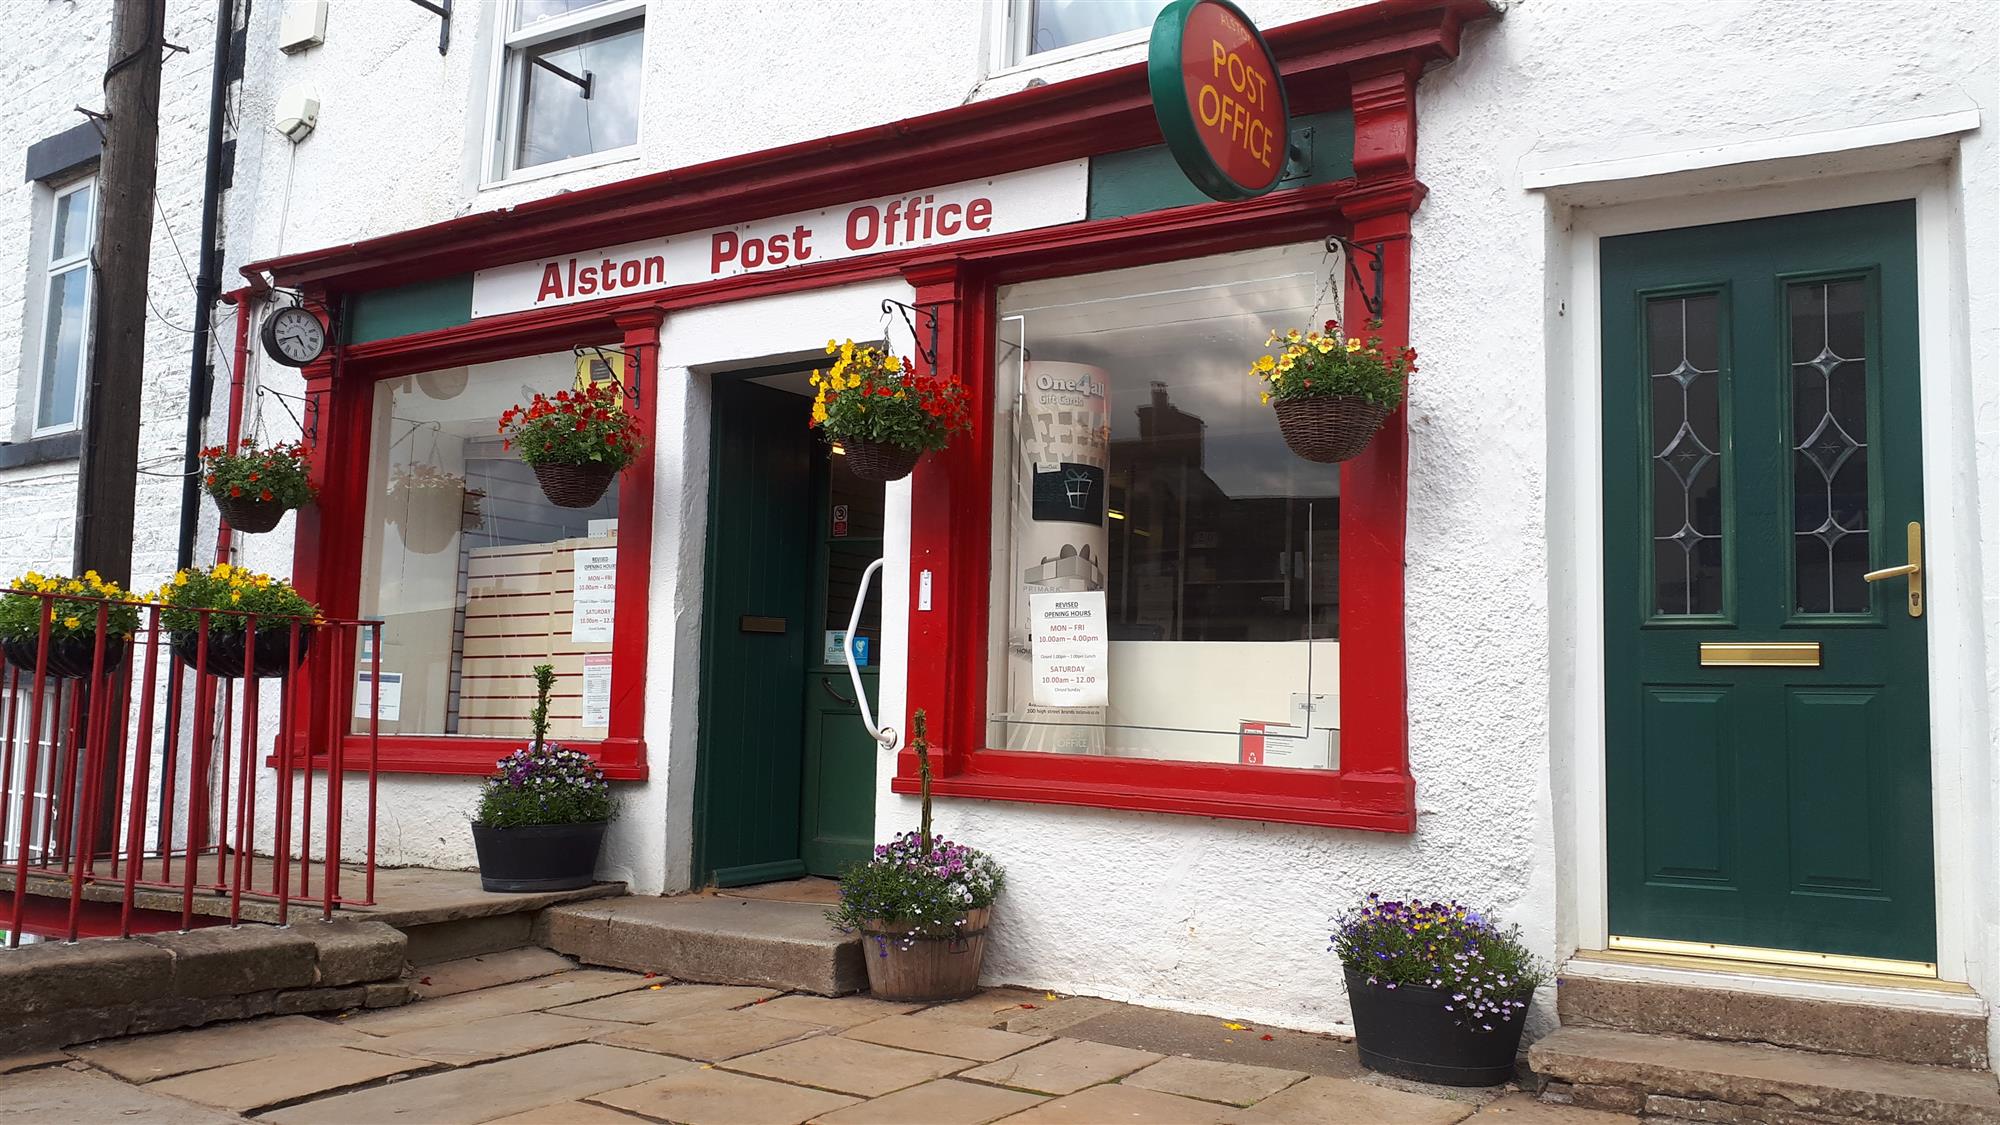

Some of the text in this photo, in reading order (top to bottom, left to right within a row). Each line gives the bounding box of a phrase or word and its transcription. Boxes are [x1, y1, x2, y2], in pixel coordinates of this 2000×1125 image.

[1221, 13, 1255, 48] ALSTON
[1213, 39, 1267, 112] POST
[1199, 84, 1273, 168] OFFICE
[537, 194, 993, 302] Alston Post Office
[1037, 374, 1105, 397] One4all
[1040, 393, 1084, 407] Gift Cards
[1072, 635, 1099, 643] 4.00pm
[1076, 676, 1096, 684] 12.00
